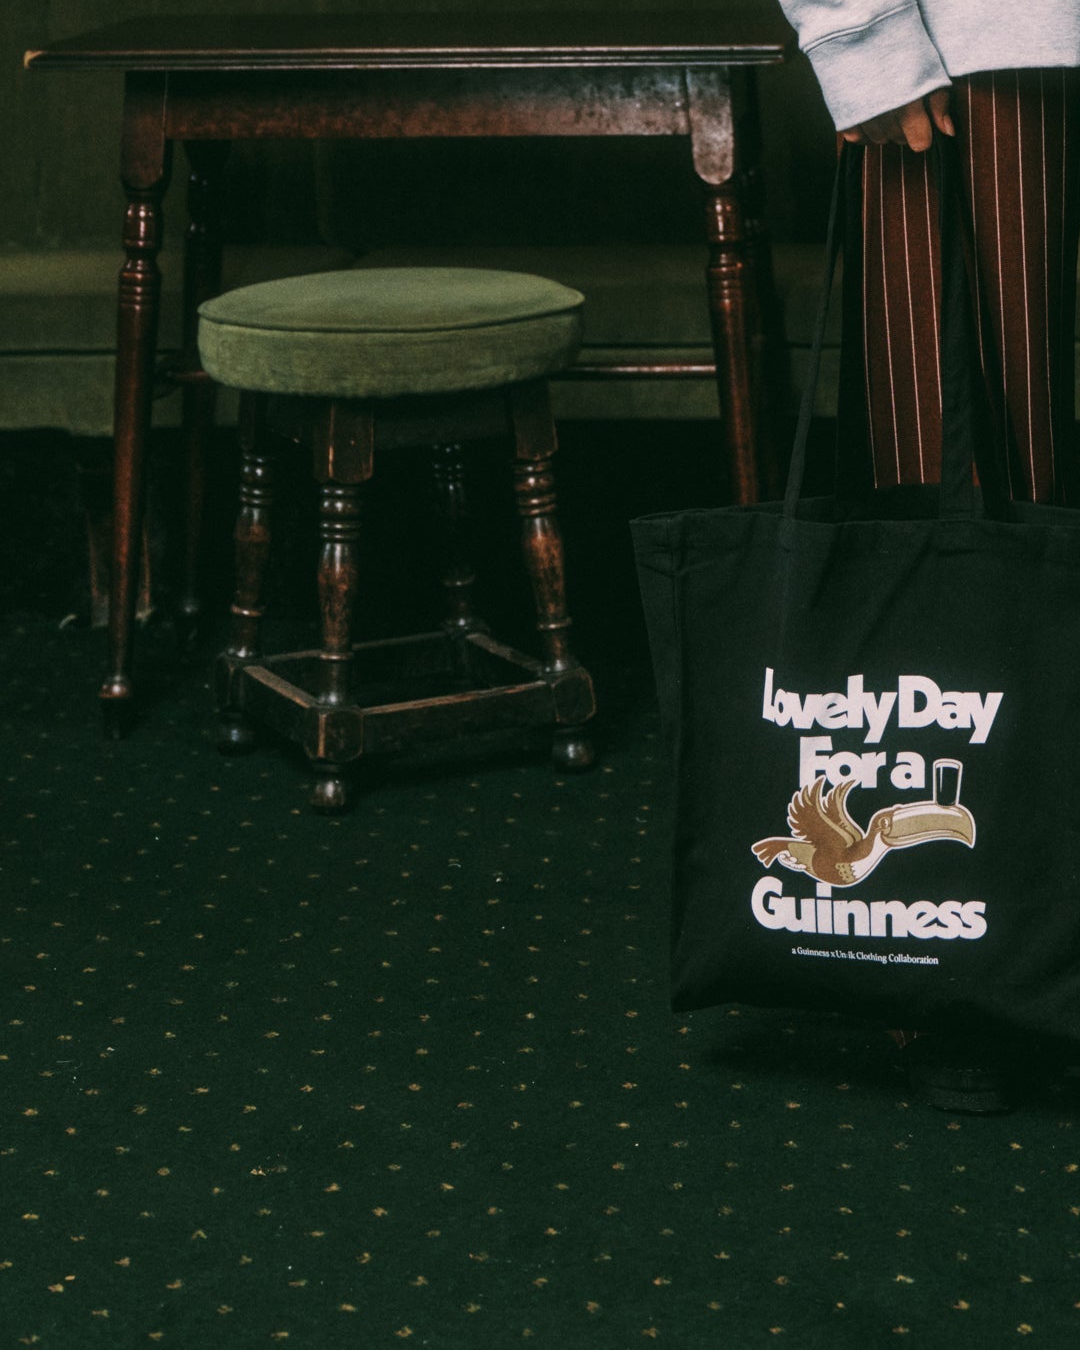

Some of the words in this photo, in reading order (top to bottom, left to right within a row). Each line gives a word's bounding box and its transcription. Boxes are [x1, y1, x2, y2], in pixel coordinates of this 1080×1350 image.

[898, 675, 1004, 744] Day
[799, 735, 887, 789] For
[890, 751, 926, 789] a
[751, 876, 988, 940] Guinness
[797, 946, 830, 958] Guinness
[856, 951, 888, 964] Clothing
[888, 953, 939, 965] Collaboration
